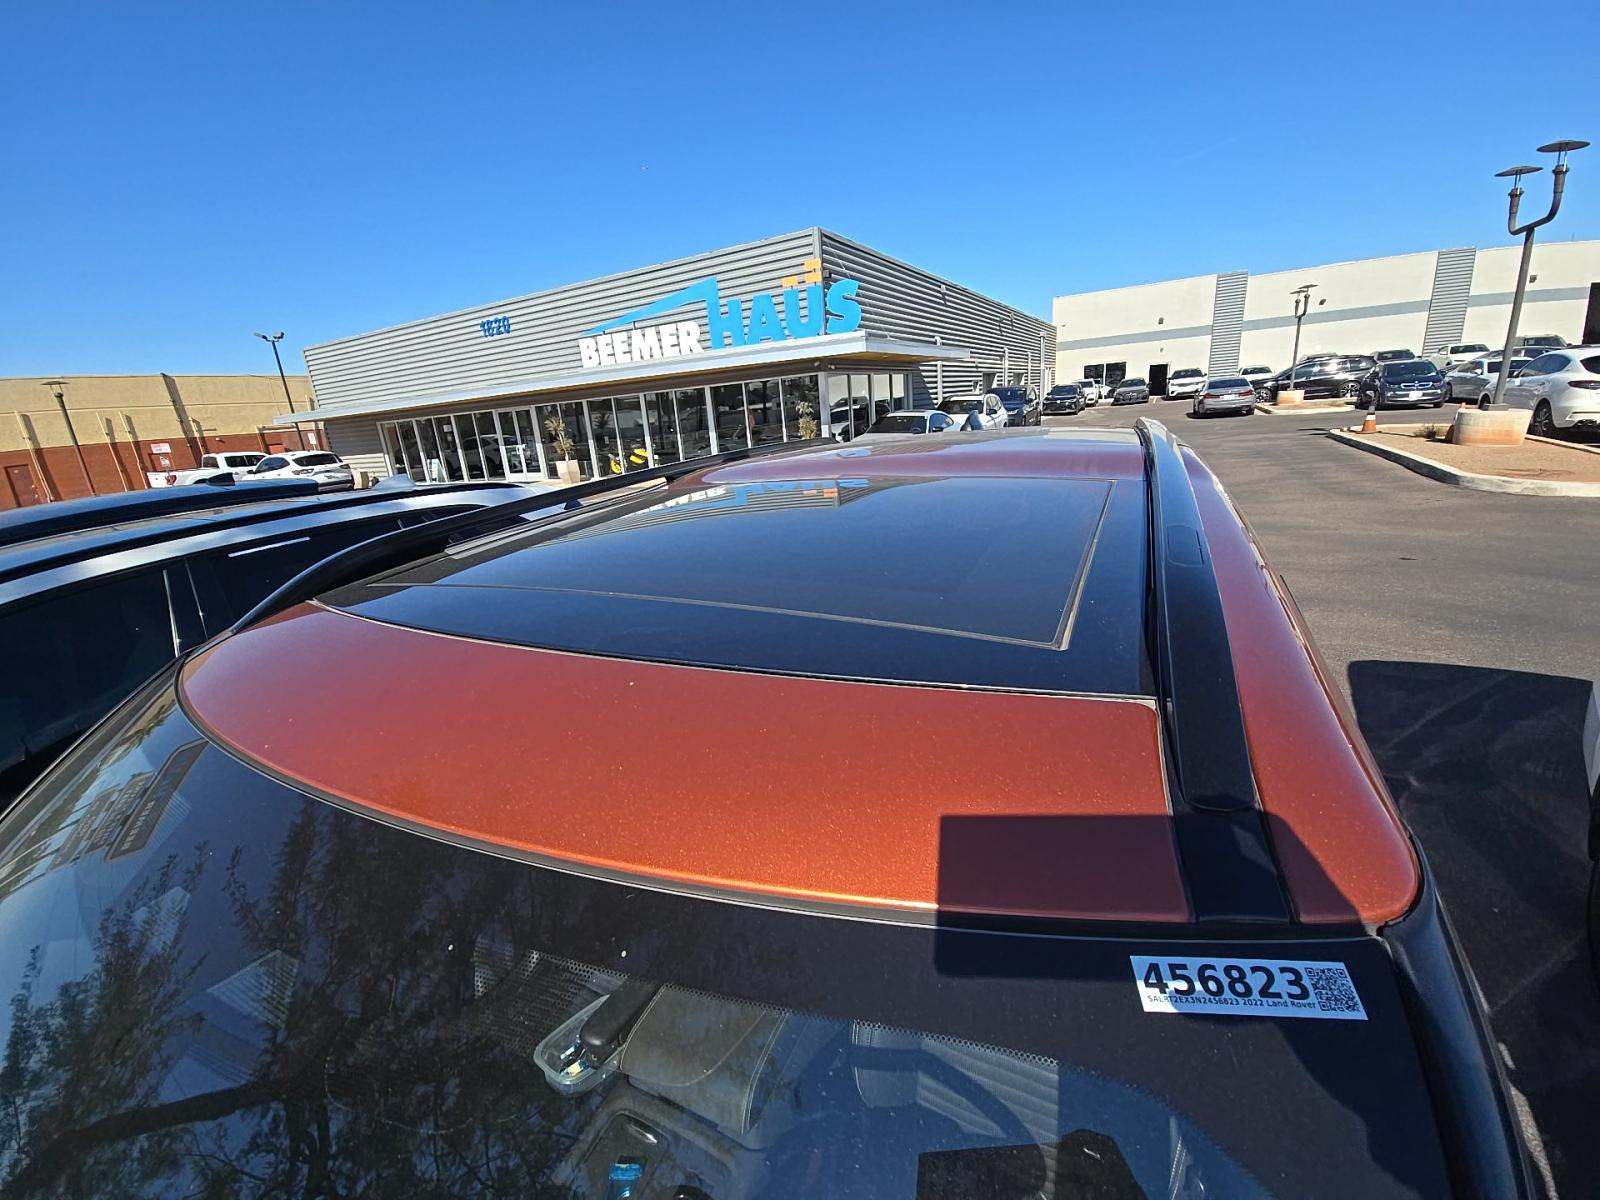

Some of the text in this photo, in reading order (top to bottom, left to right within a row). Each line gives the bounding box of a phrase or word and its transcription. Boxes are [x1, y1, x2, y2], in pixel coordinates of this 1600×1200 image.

[480, 316, 510, 337] 1820
[578, 320, 704, 369] BEEMER
[1143, 963, 1310, 1000] 456823
[1243, 998, 1264, 1007] 2022
[1266, 999, 1289, 1008] Land
[1290, 1000, 1316, 1009] Rover
